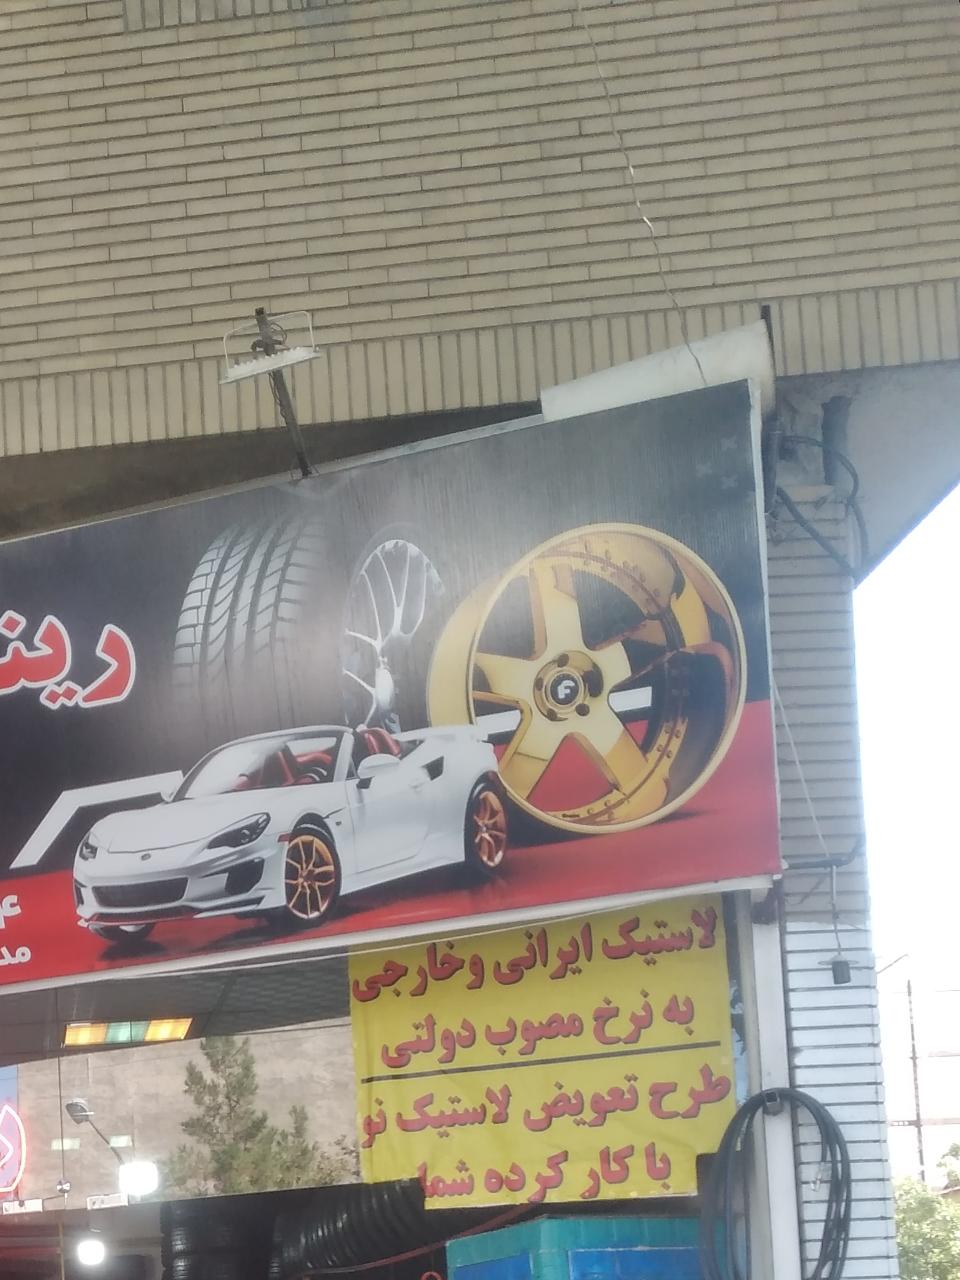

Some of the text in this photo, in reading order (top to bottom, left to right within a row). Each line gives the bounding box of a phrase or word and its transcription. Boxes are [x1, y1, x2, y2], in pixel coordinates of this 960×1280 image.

[492, 921, 594, 987] ایرانی
[601, 904, 719, 967] لاستیک
[380, 987, 696, 1069] به نرخ مصوب دولتی
[360, 1062, 732, 1149] طرح تعویض لاستیک نو
[417, 1160, 476, 1200] شما
[643, 1141, 673, 1192] با
